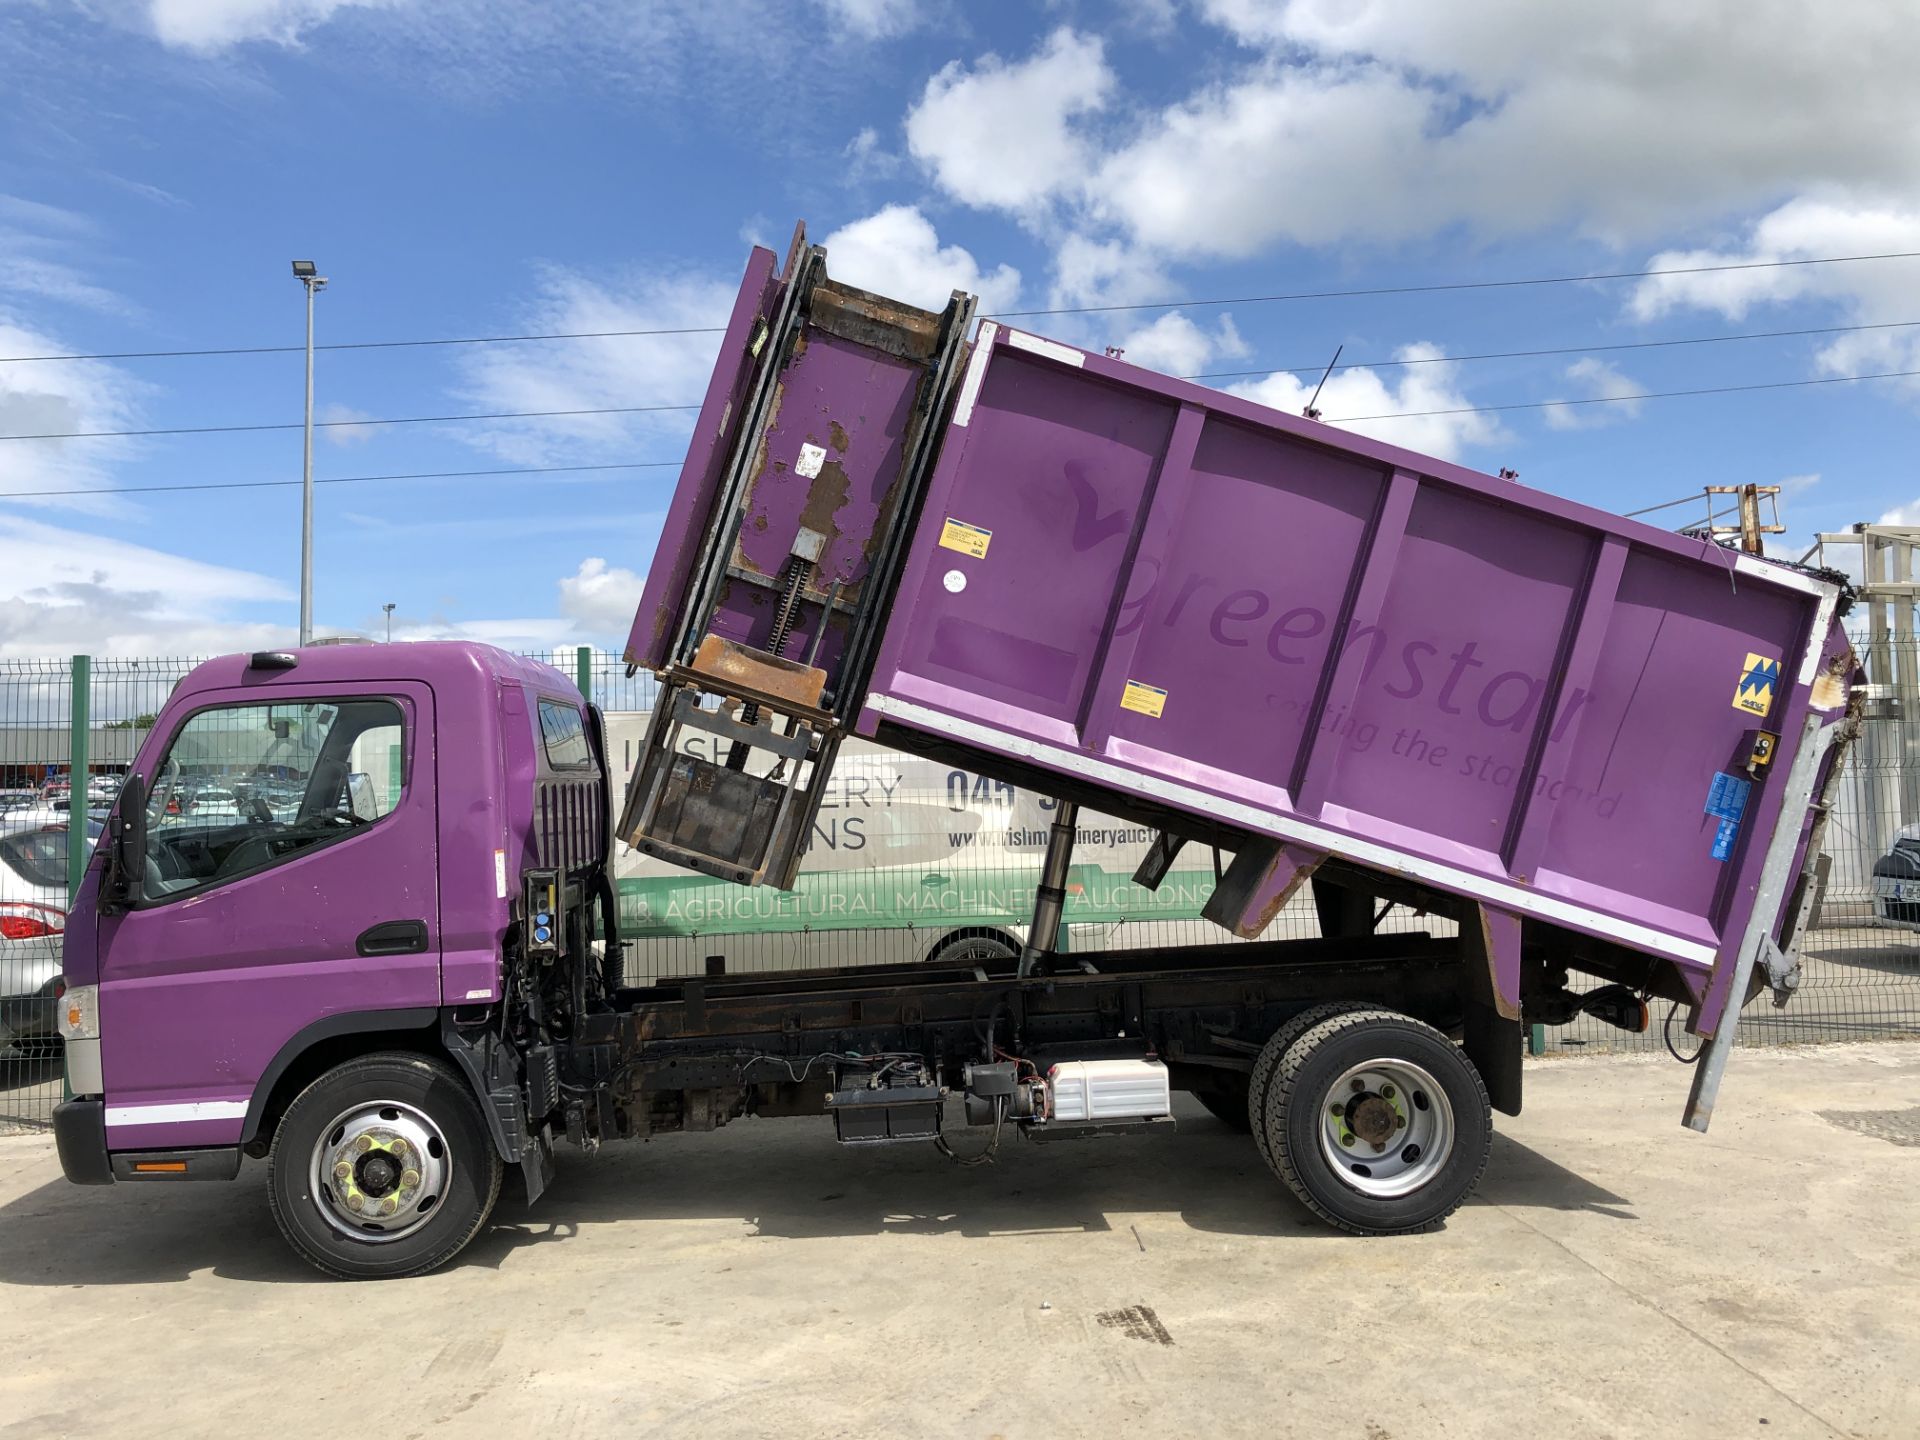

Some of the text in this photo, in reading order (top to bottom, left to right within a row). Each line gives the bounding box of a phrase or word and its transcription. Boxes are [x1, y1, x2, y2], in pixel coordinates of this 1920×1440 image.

[1090, 554, 1596, 743] greenstar
[1391, 729, 1448, 767] the
[663, 893, 884, 922] AGRICULTURAL
